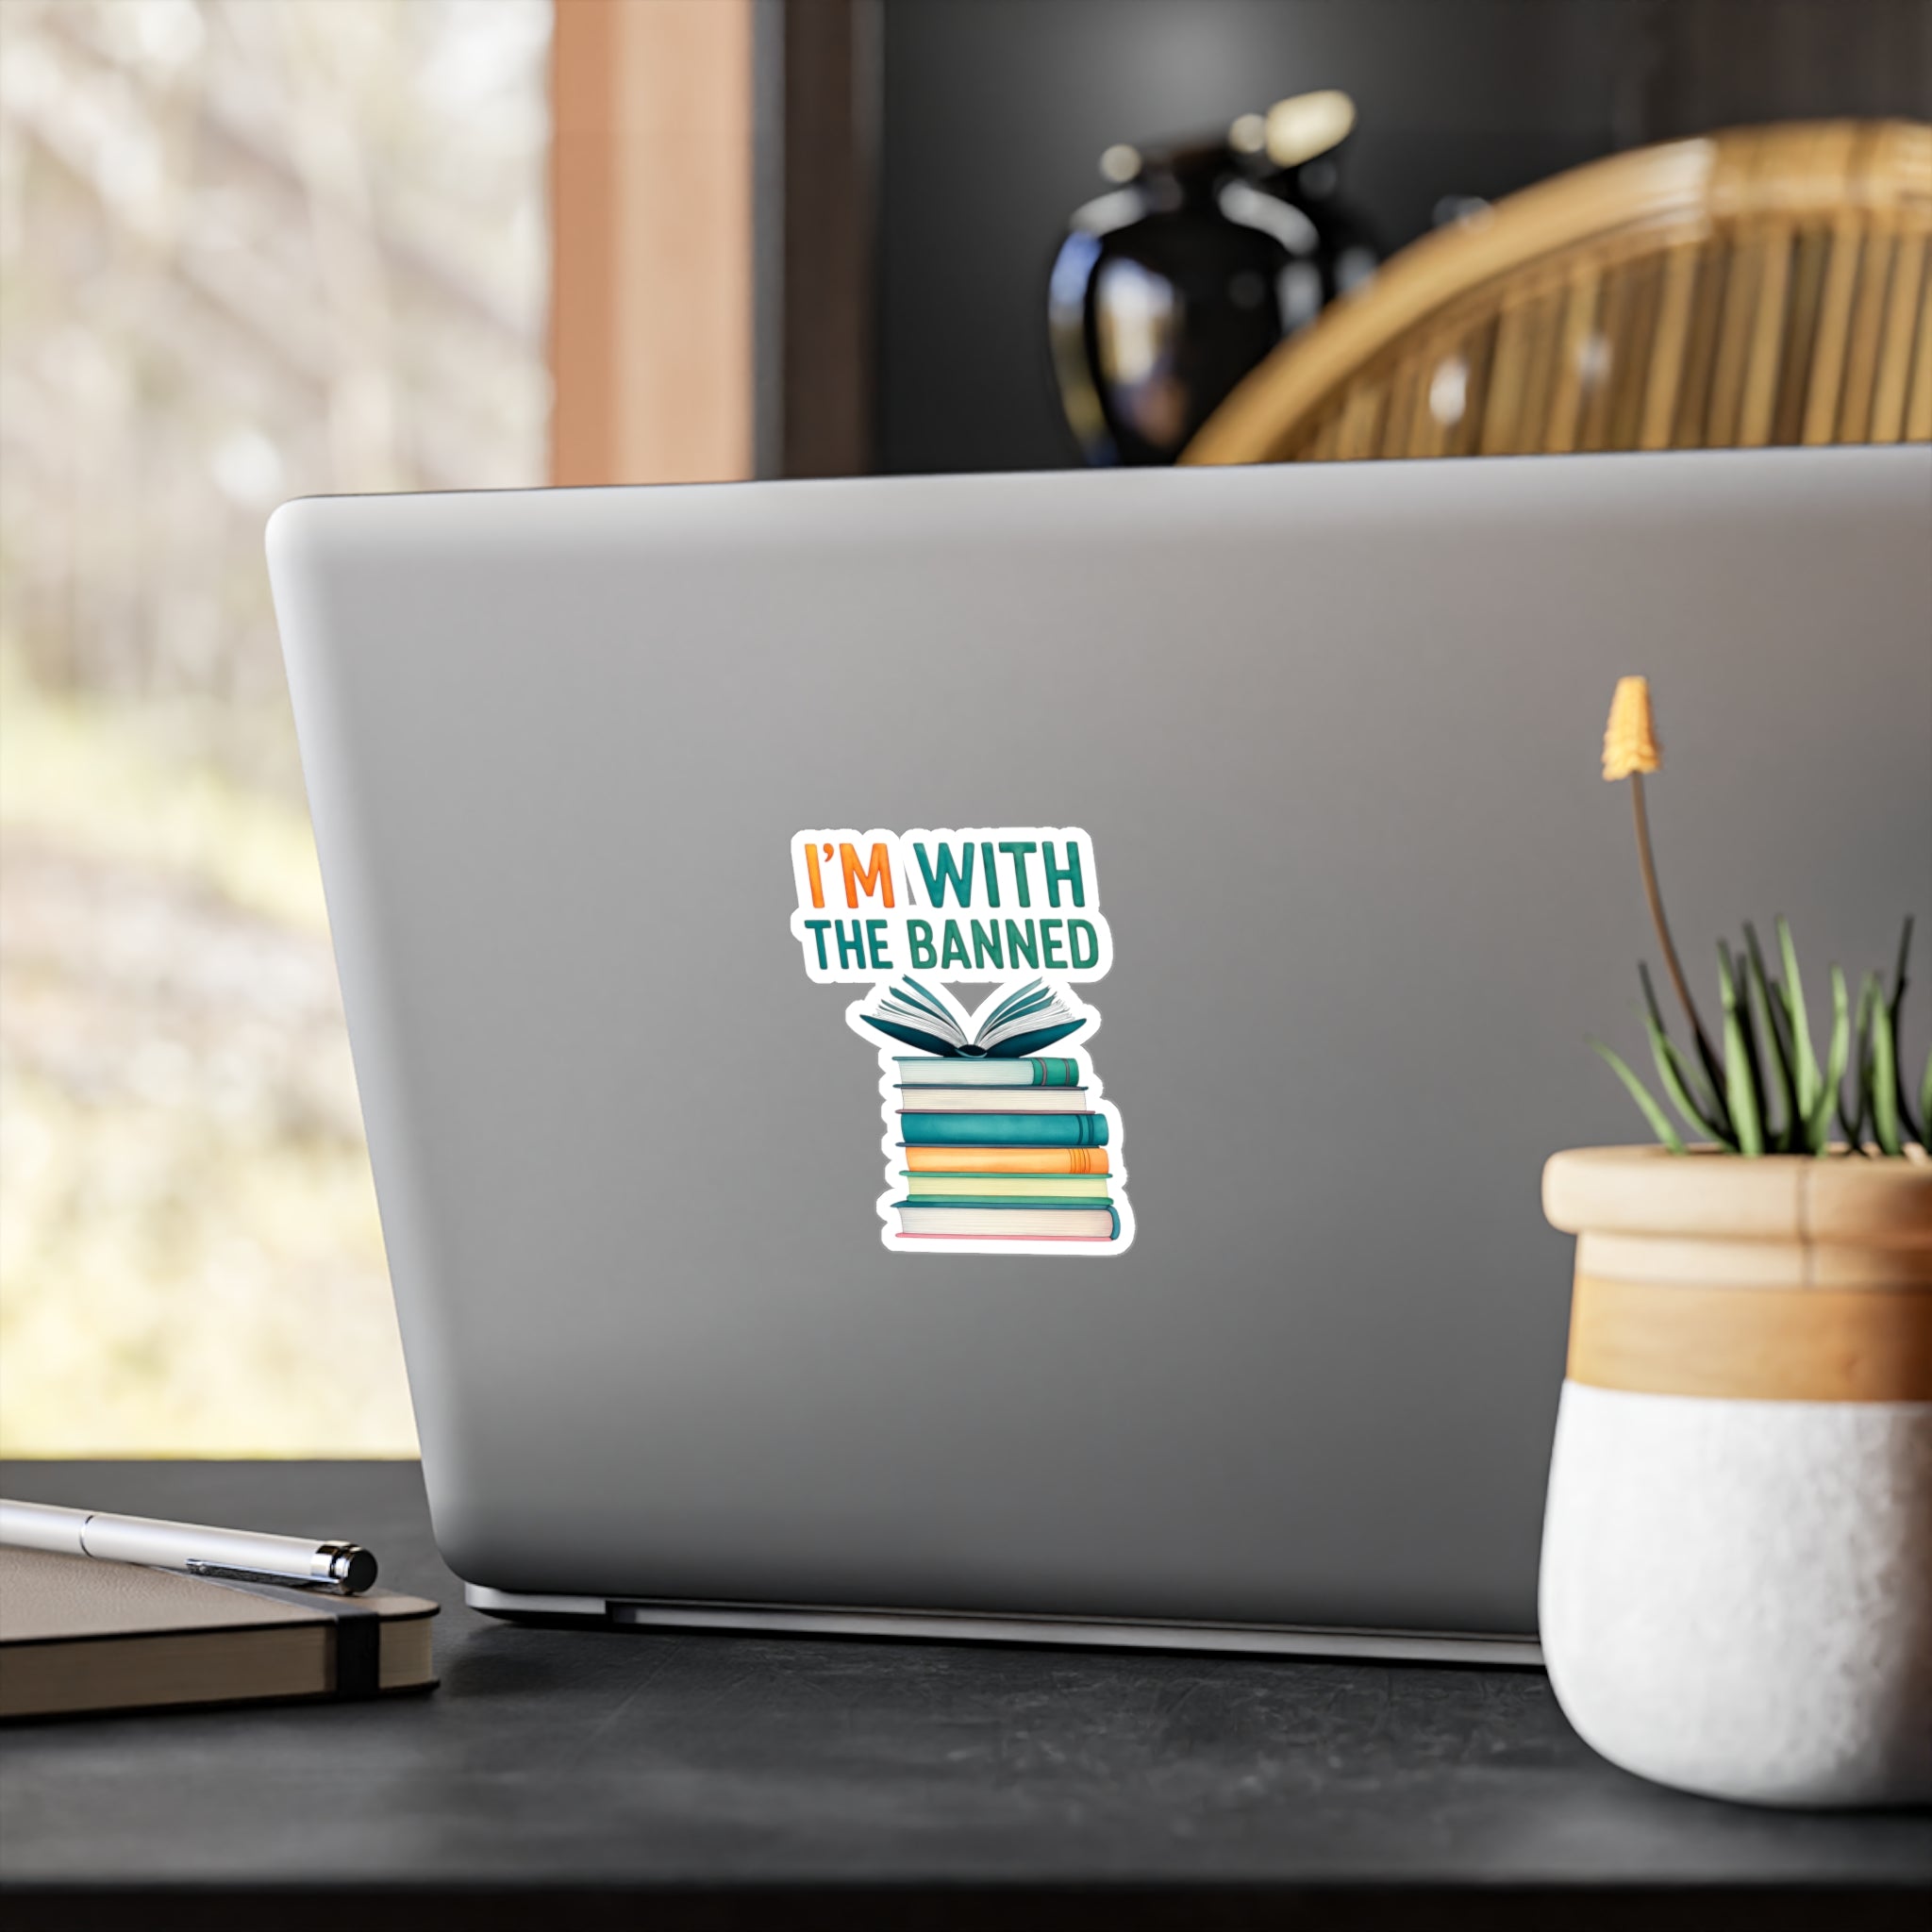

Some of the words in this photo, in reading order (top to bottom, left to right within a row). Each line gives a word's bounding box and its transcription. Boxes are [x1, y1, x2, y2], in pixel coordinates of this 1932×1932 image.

[804, 842, 895, 908] I'M
[913, 841, 1085, 908] WITH
[804, 919, 893, 970] THE
[907, 918, 1099, 970] BANNED
